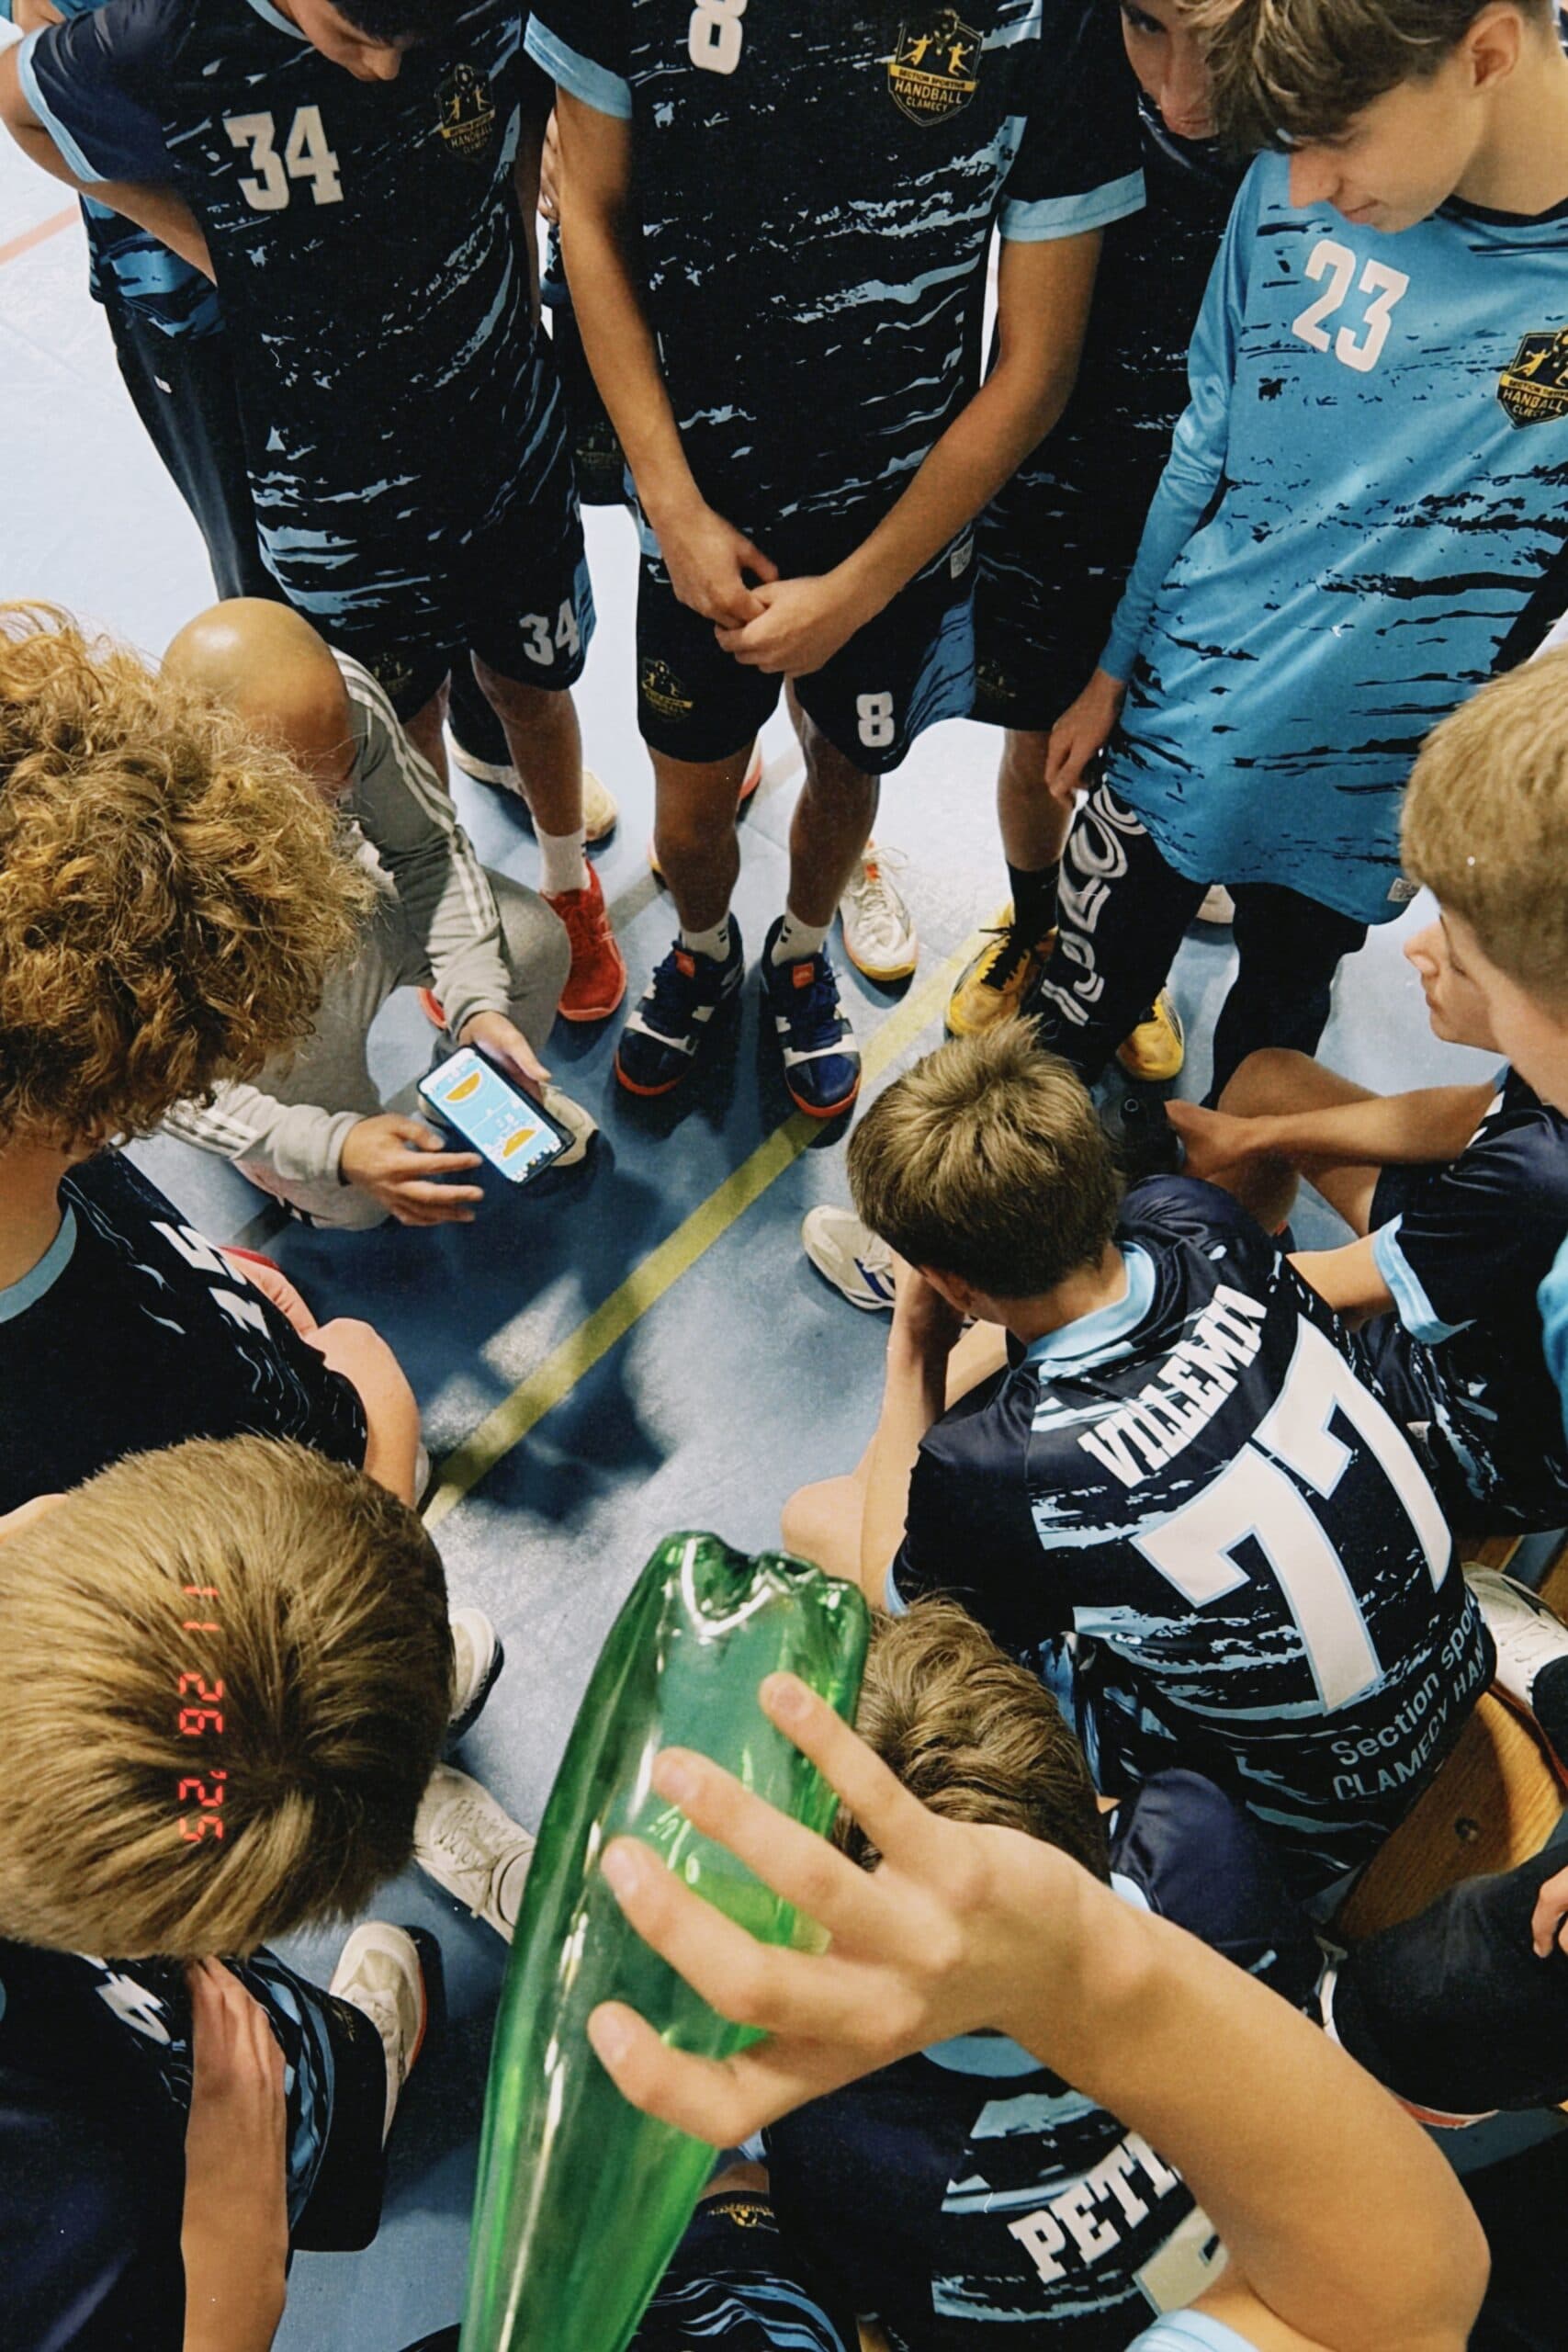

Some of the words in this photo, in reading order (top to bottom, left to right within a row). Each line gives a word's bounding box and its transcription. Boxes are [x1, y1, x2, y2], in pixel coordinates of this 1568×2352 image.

[688, 0, 748, 74] 8
[895, 79, 962, 104] HANDBALL
[906, 96, 947, 111] CLAMECY
[222, 105, 344, 210] 34
[1292, 239, 1410, 372] 23
[519, 598, 581, 666] 34
[856, 691, 895, 747] 8
[1128, 1312, 1452, 1716] 77
[1331, 1672, 1440, 1765] Section
[1332, 1697, 1448, 1801] CLAMECY
[1007, 2132, 1182, 2285] PETI
